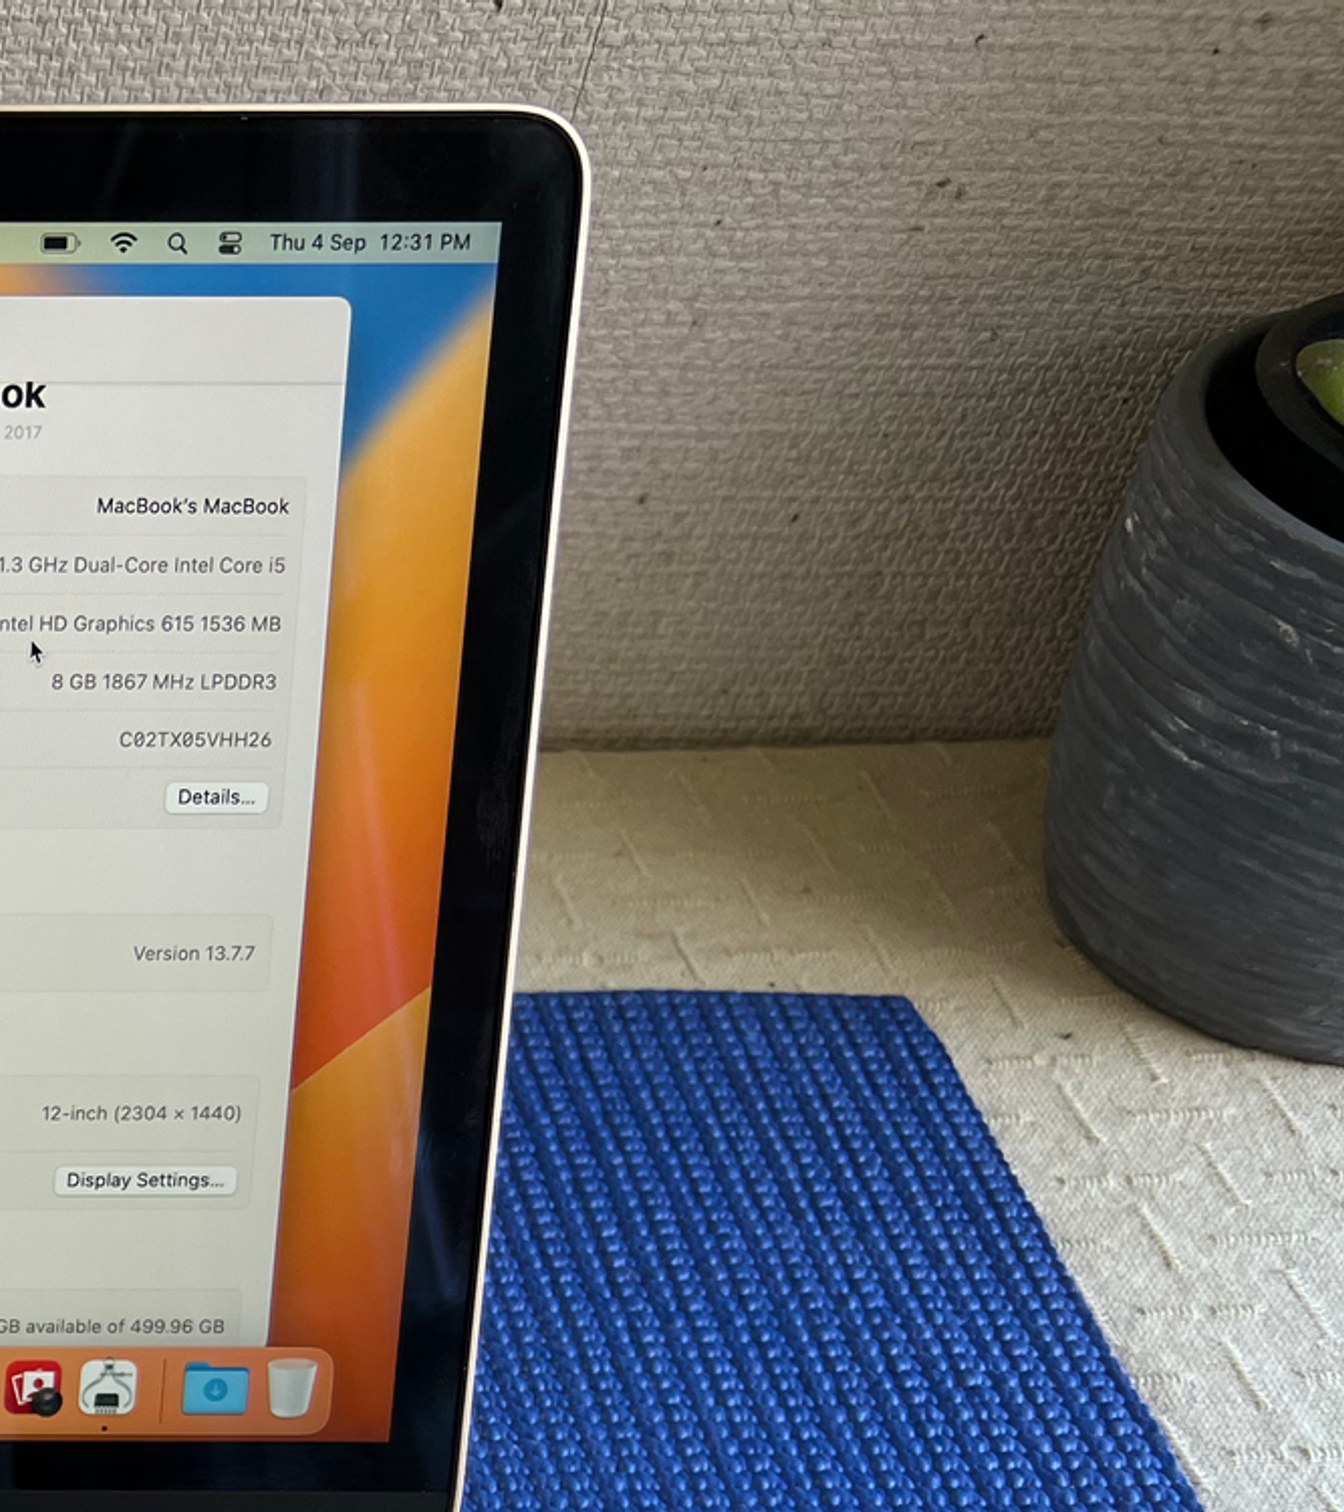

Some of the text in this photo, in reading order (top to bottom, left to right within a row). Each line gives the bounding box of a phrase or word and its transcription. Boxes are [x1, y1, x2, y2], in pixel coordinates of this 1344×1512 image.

[270, 232, 472, 255] Thu 4 Sep 12:31 PM
[3, 424, 43, 441] 2017
[203, 497, 290, 515] MacBook
[28, 555, 69, 574] GHz
[73, 555, 169, 574] Dual-Core
[174, 556, 215, 574] Intel
[219, 556, 264, 574] Core
[268, 556, 286, 575] i5
[39, 614, 68, 632] HD
[73, 614, 155, 635] Graphics
[160, 614, 195, 633] 615
[200, 614, 246, 633] 1536
[251, 615, 282, 633] MB
[51, 673, 277, 691] 8 GB 1867 MHz LPDDR3
[119, 730, 273, 748] C02TX05VHH26
[133, 944, 256, 962] Version 13.7.7
[66, 1171, 132, 1192] Display
[26, 1319, 102, 1335] available
[106, 1318, 126, 1335] of
[129, 1318, 195, 1335] 499.96
[199, 1318, 226, 1335] GB
